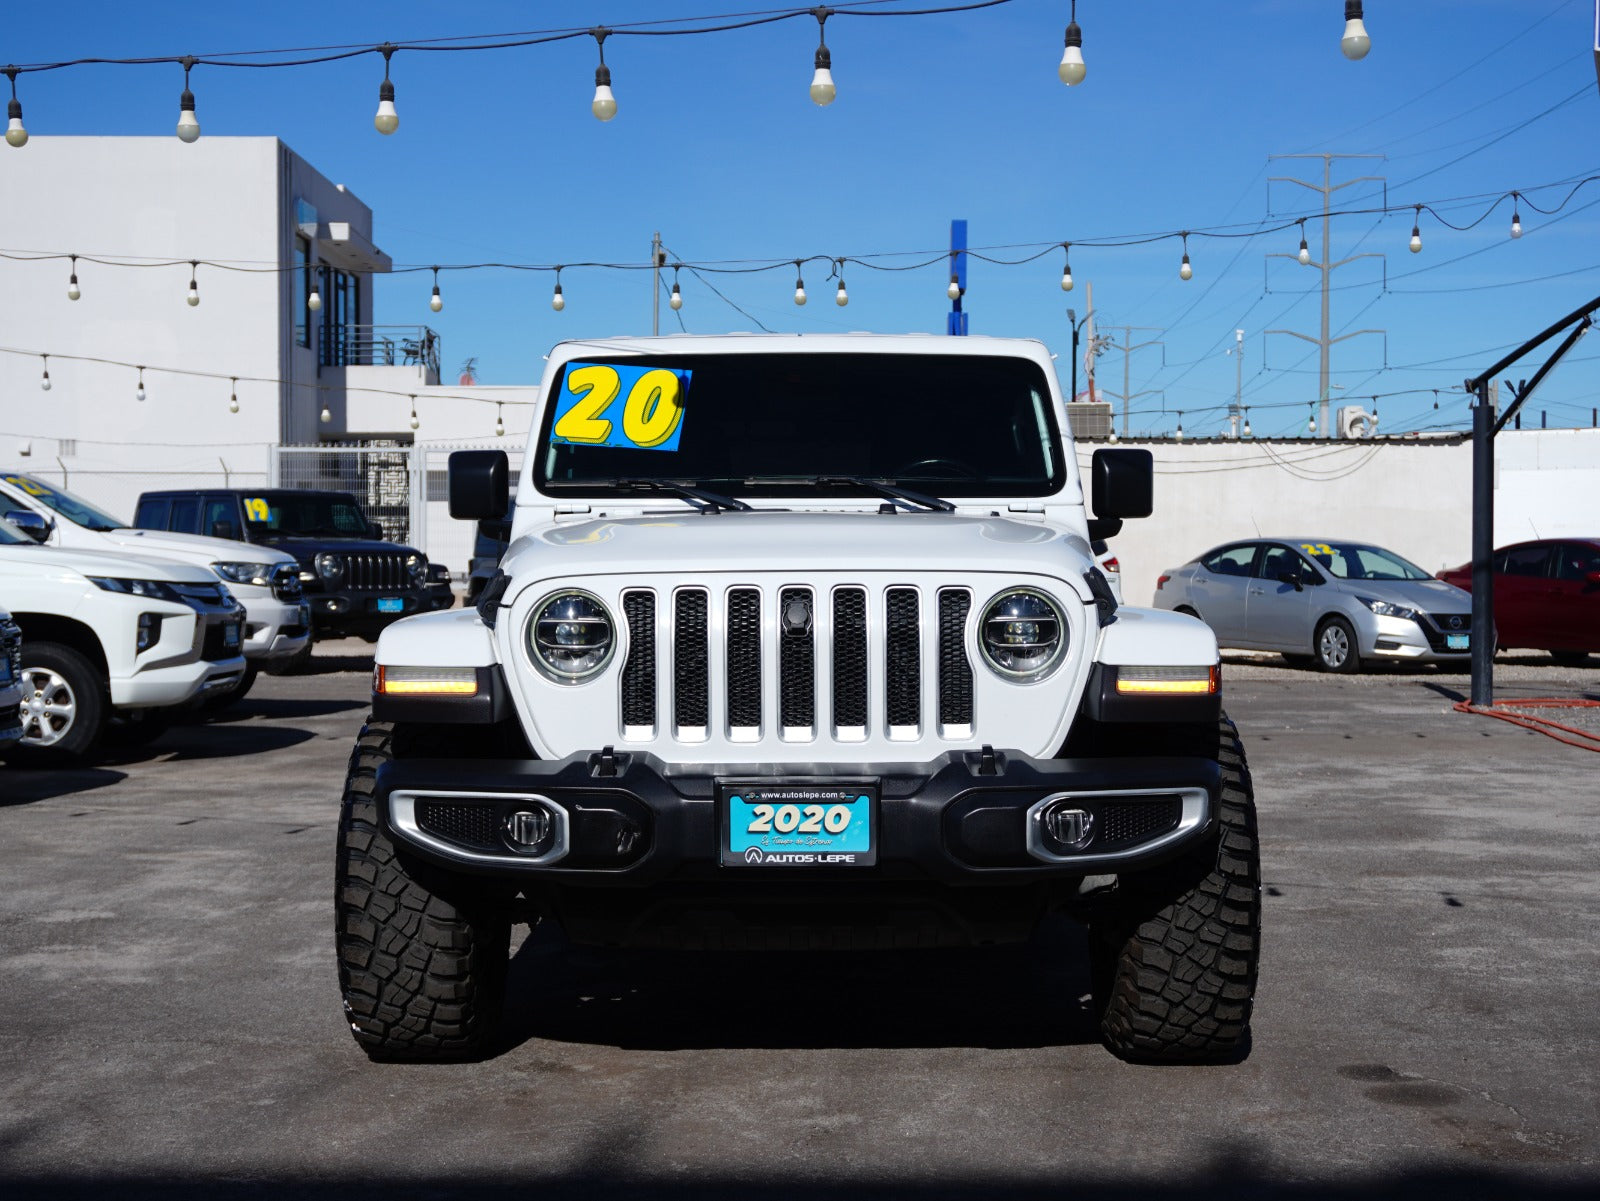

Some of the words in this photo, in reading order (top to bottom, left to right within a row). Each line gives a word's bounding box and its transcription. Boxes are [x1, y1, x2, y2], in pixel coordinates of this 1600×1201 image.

[554, 365, 684, 448] 20
[243, 498, 269, 521] 19
[1300, 543, 1337, 555] 22
[761, 791, 838, 799] www.autoslepe.com
[747, 804, 852, 834] 2020
